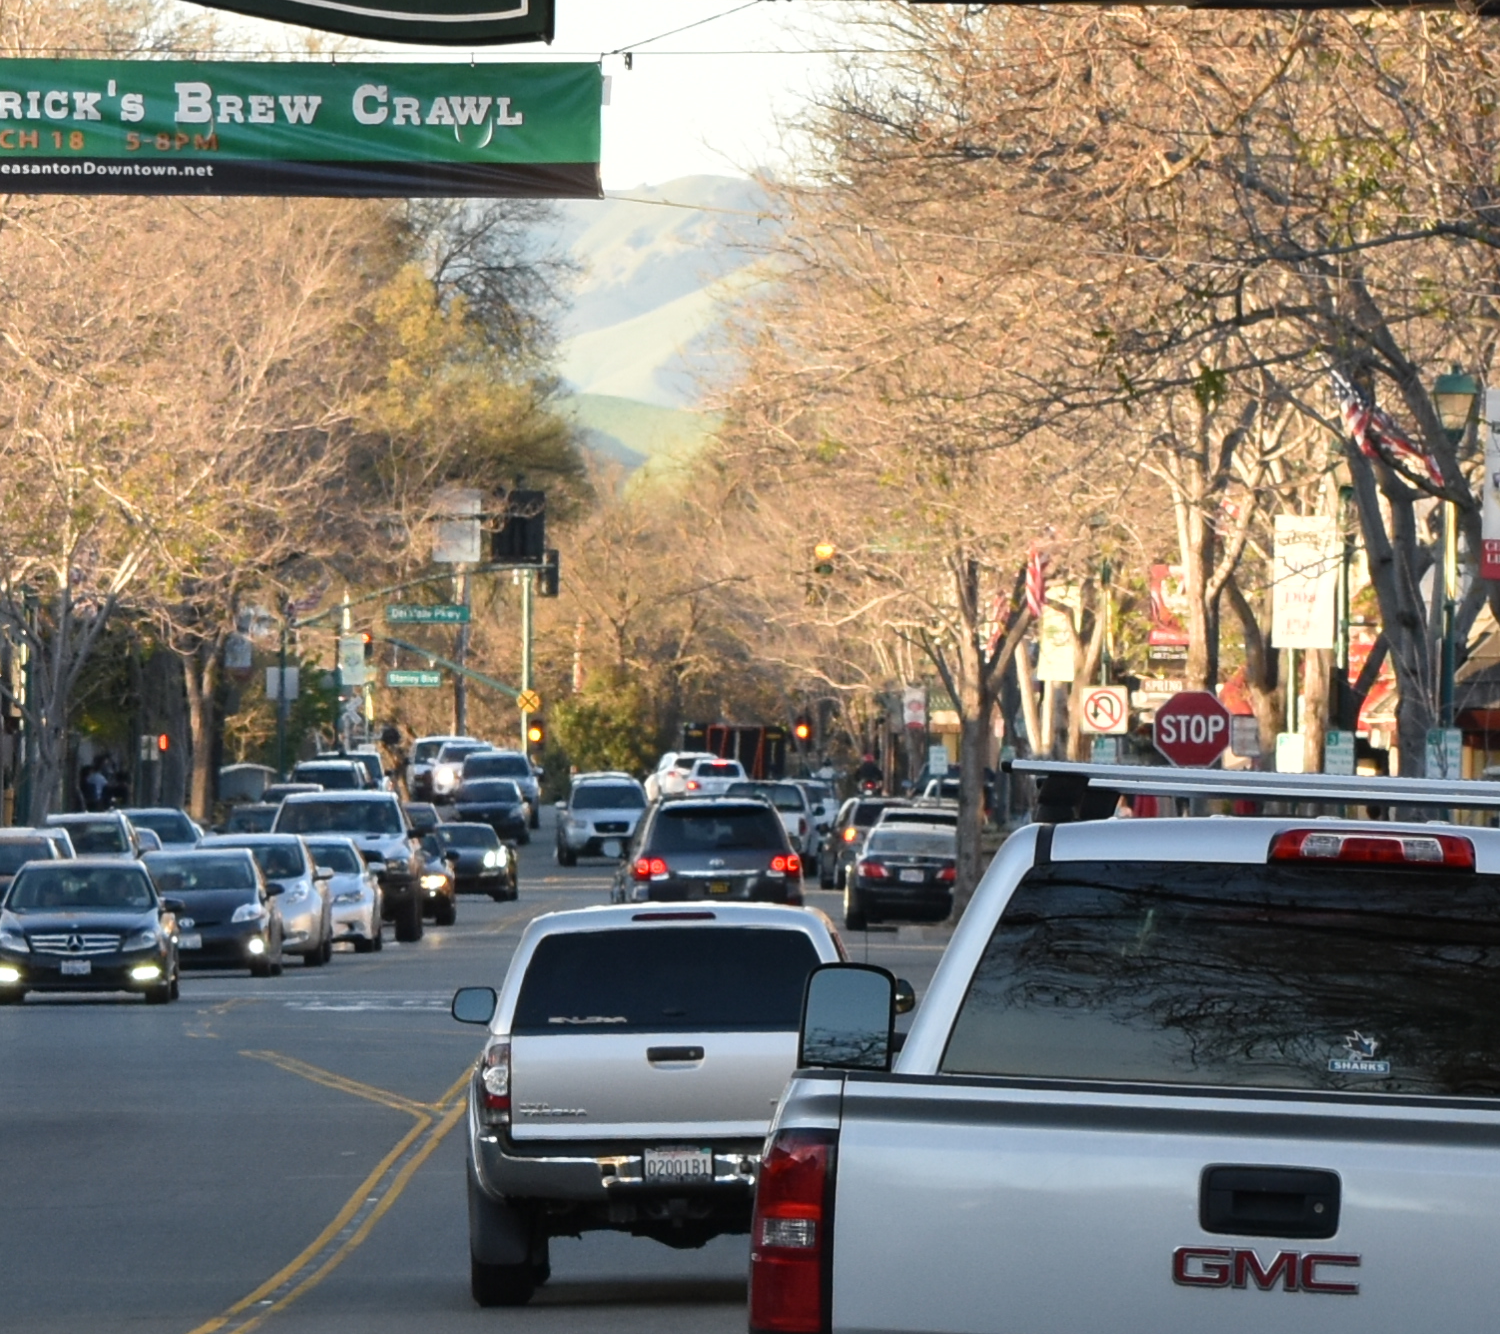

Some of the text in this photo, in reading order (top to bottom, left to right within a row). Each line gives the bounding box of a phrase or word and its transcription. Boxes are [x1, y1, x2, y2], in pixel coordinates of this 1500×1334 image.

[53, 129, 85, 151] 18
[125, 129, 219, 152] 5-8PM
[1145, 680, 1183, 692] SPRING
[1160, 714, 1225, 744] STOP
[1333, 1061, 1386, 1072] SHARKS
[1171, 1245, 1362, 1295] GMC
